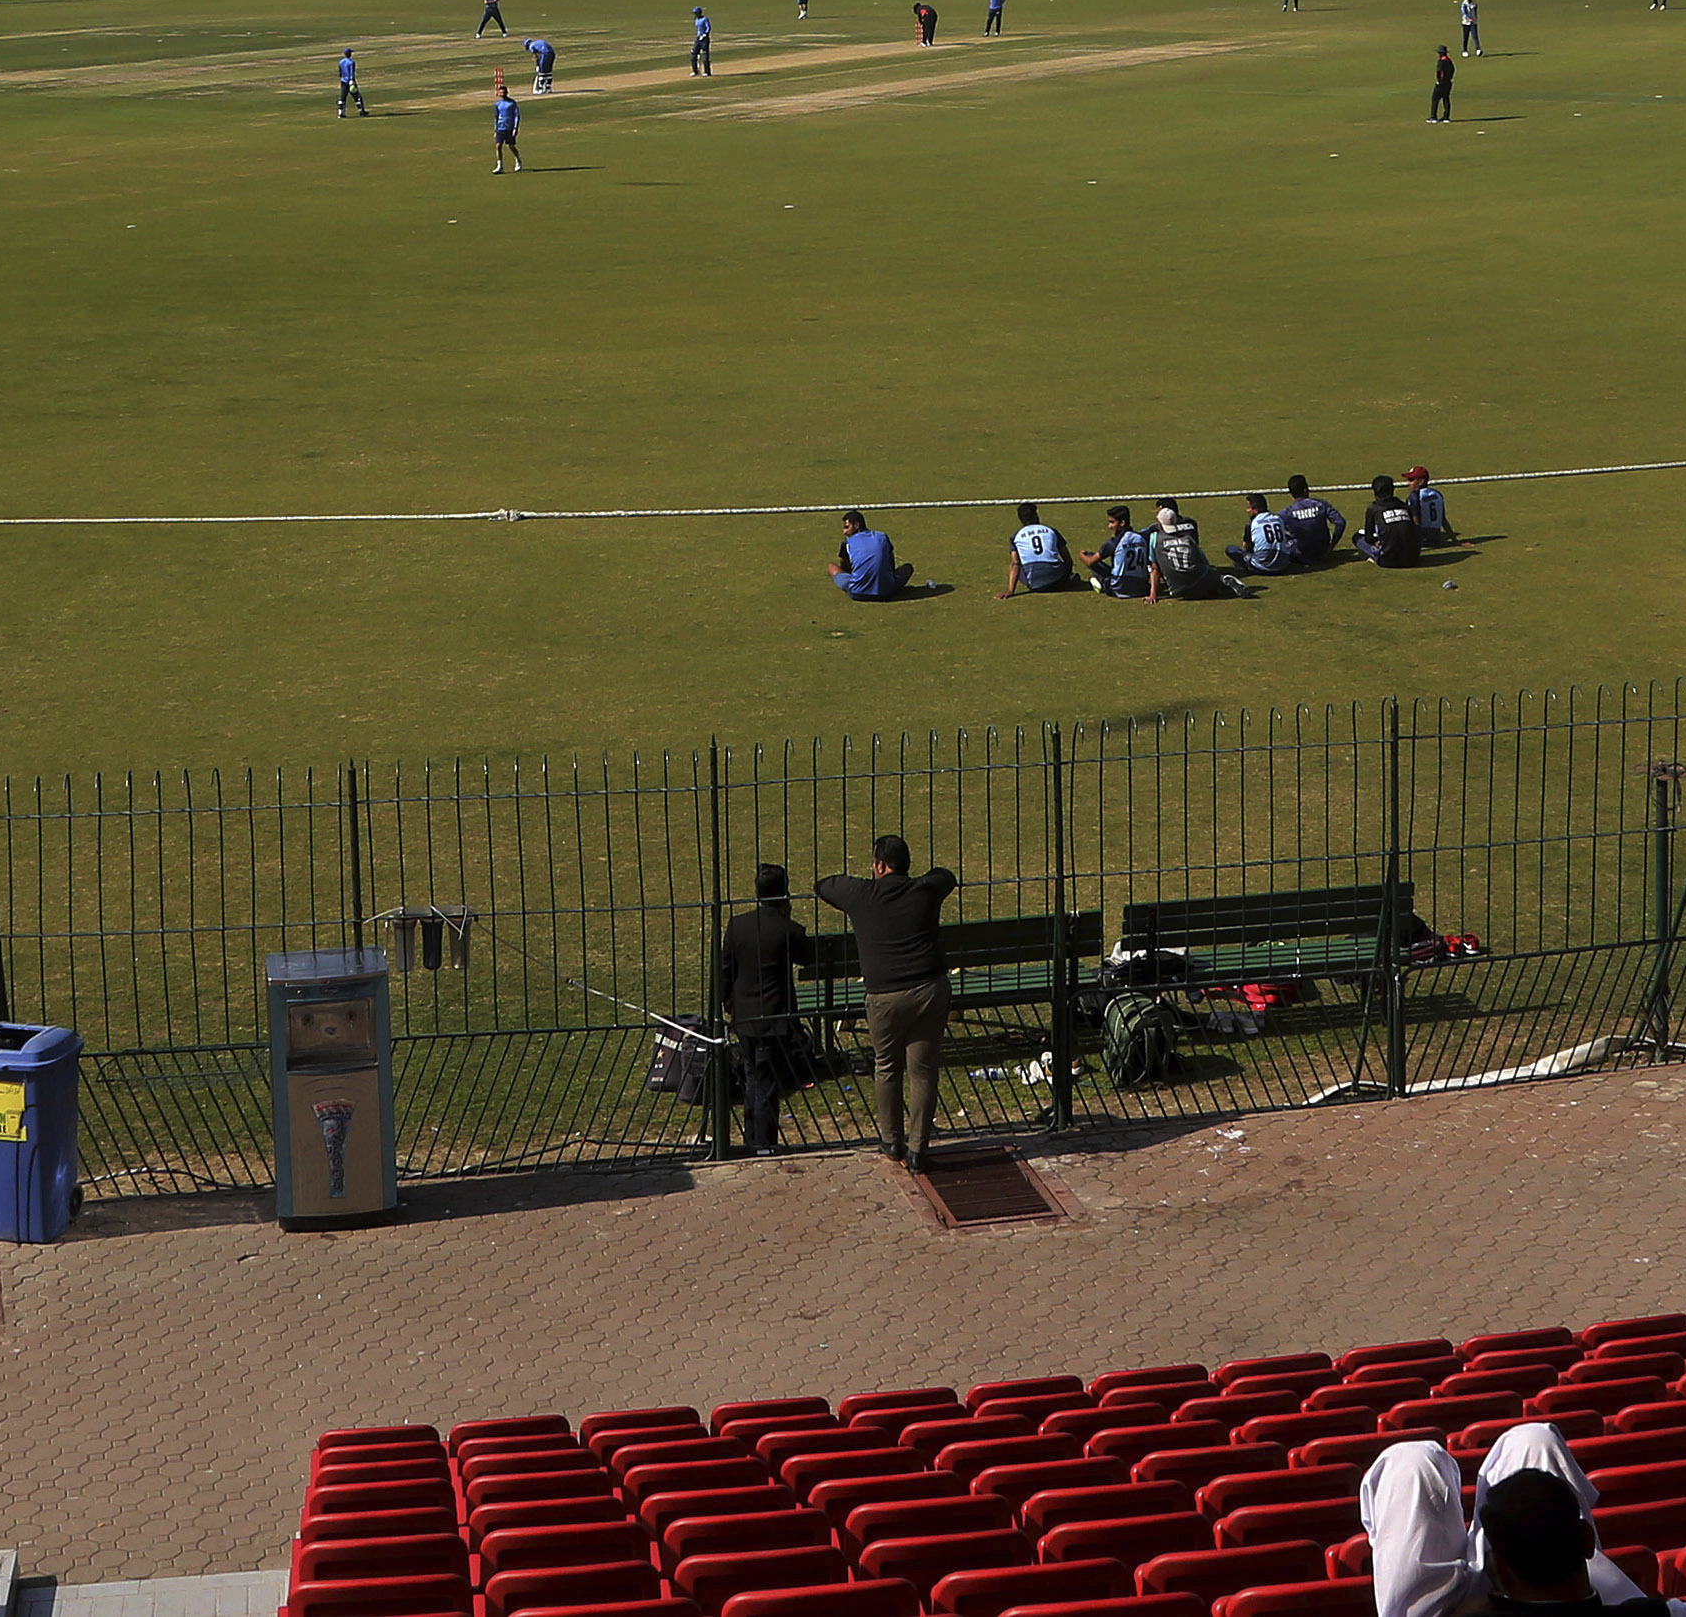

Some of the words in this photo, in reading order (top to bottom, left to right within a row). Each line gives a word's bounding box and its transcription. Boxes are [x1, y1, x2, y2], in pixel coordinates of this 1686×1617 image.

[1429, 502, 1437, 521] 6
[1263, 523, 1284, 544] 66
[1032, 535, 1043, 555] 9
[1167, 547, 1189, 570] 17
